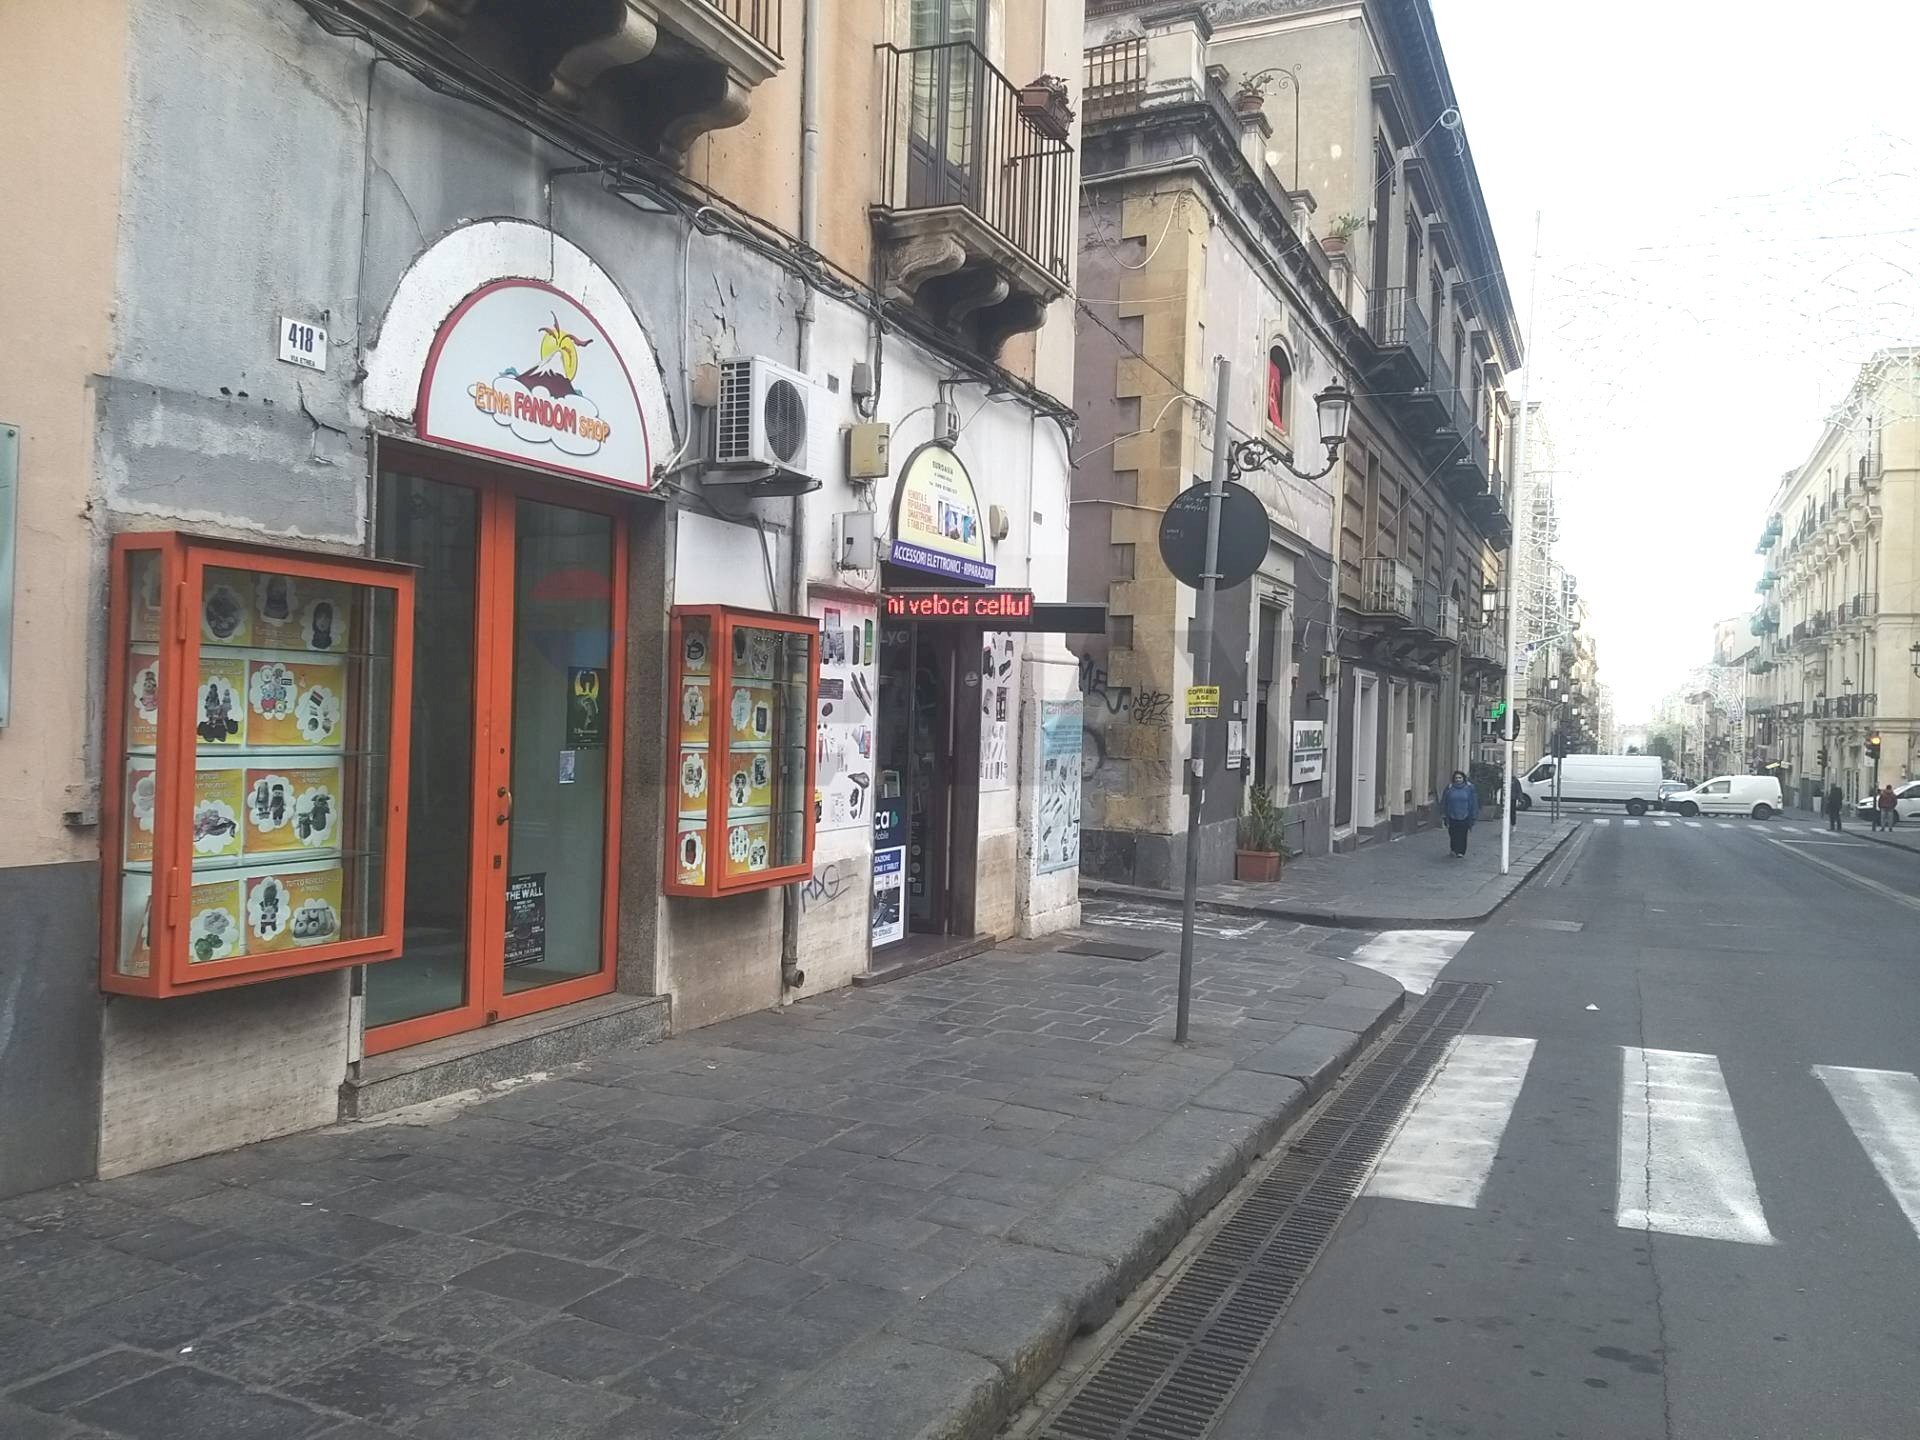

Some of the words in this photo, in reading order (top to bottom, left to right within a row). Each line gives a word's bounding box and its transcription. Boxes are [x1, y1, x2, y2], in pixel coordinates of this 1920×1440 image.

[289, 323, 313, 352] 418
[475, 382, 512, 416] ETNA
[514, 391, 577, 435] FANDOM
[579, 416, 611, 443] SHOP
[893, 545, 926, 566] ACCESSORI
[926, 554, 961, 573] ELETTRONICI
[963, 563, 994, 581] RIPARAZIONI
[888, 594, 904, 614] ni
[909, 594, 968, 615] veloci
[975, 594, 1030, 616] cellul
[506, 890, 520, 901] THE
[522, 887, 543, 899] WALL
